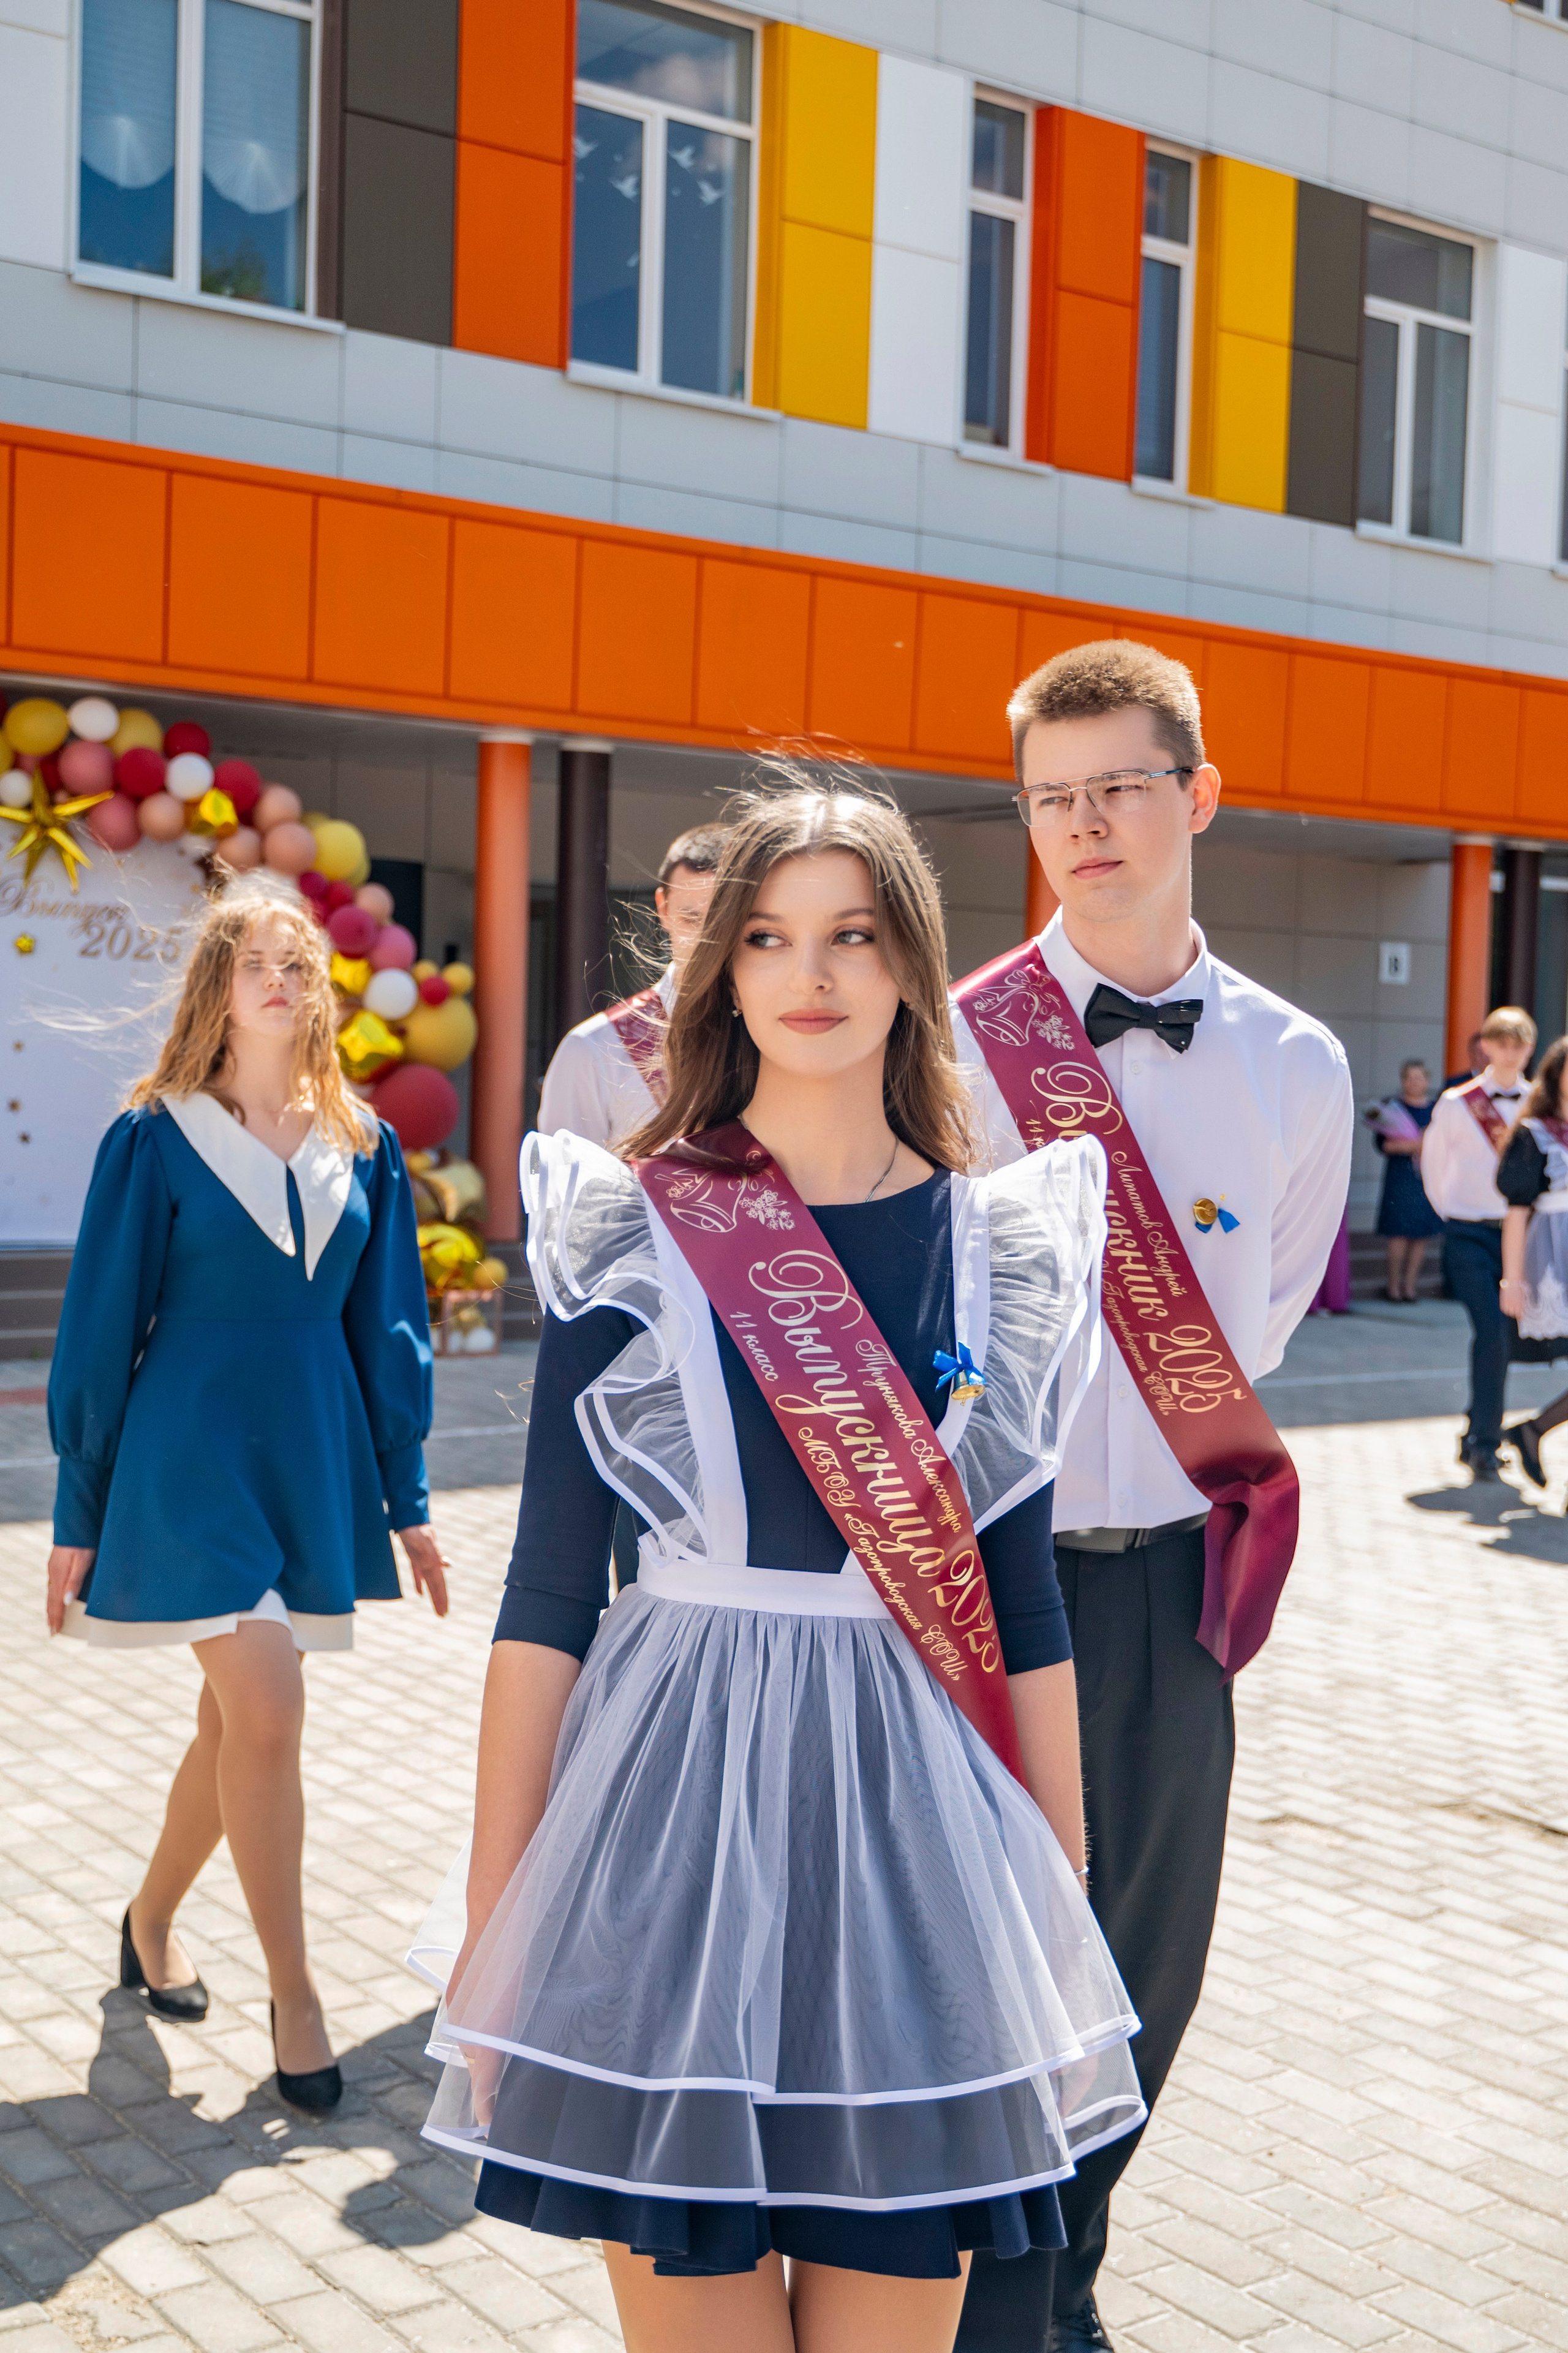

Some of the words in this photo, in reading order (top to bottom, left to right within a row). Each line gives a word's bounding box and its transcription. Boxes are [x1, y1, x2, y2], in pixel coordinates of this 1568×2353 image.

[80, 921, 183, 964] 2025
[1111, 1151, 1163, 1230] Липатов
[1147, 1231, 1188, 1297] Андрей
[730, 1311, 758, 1328] 11
[742, 1334, 778, 1382] класс
[1143, 1324, 1247, 1413] 2025
[748, 1250, 945, 1577] Выпускница
[927, 1549, 1000, 1673] 2025
[856, 1339, 924, 1439] Трунякова
[910, 1439, 962, 1533] Александра
[798, 1427, 861, 1507] МБОУ
[843, 1513, 923, 1630] «Газопроводская
[920, 1624, 968, 1681] СОШ»
